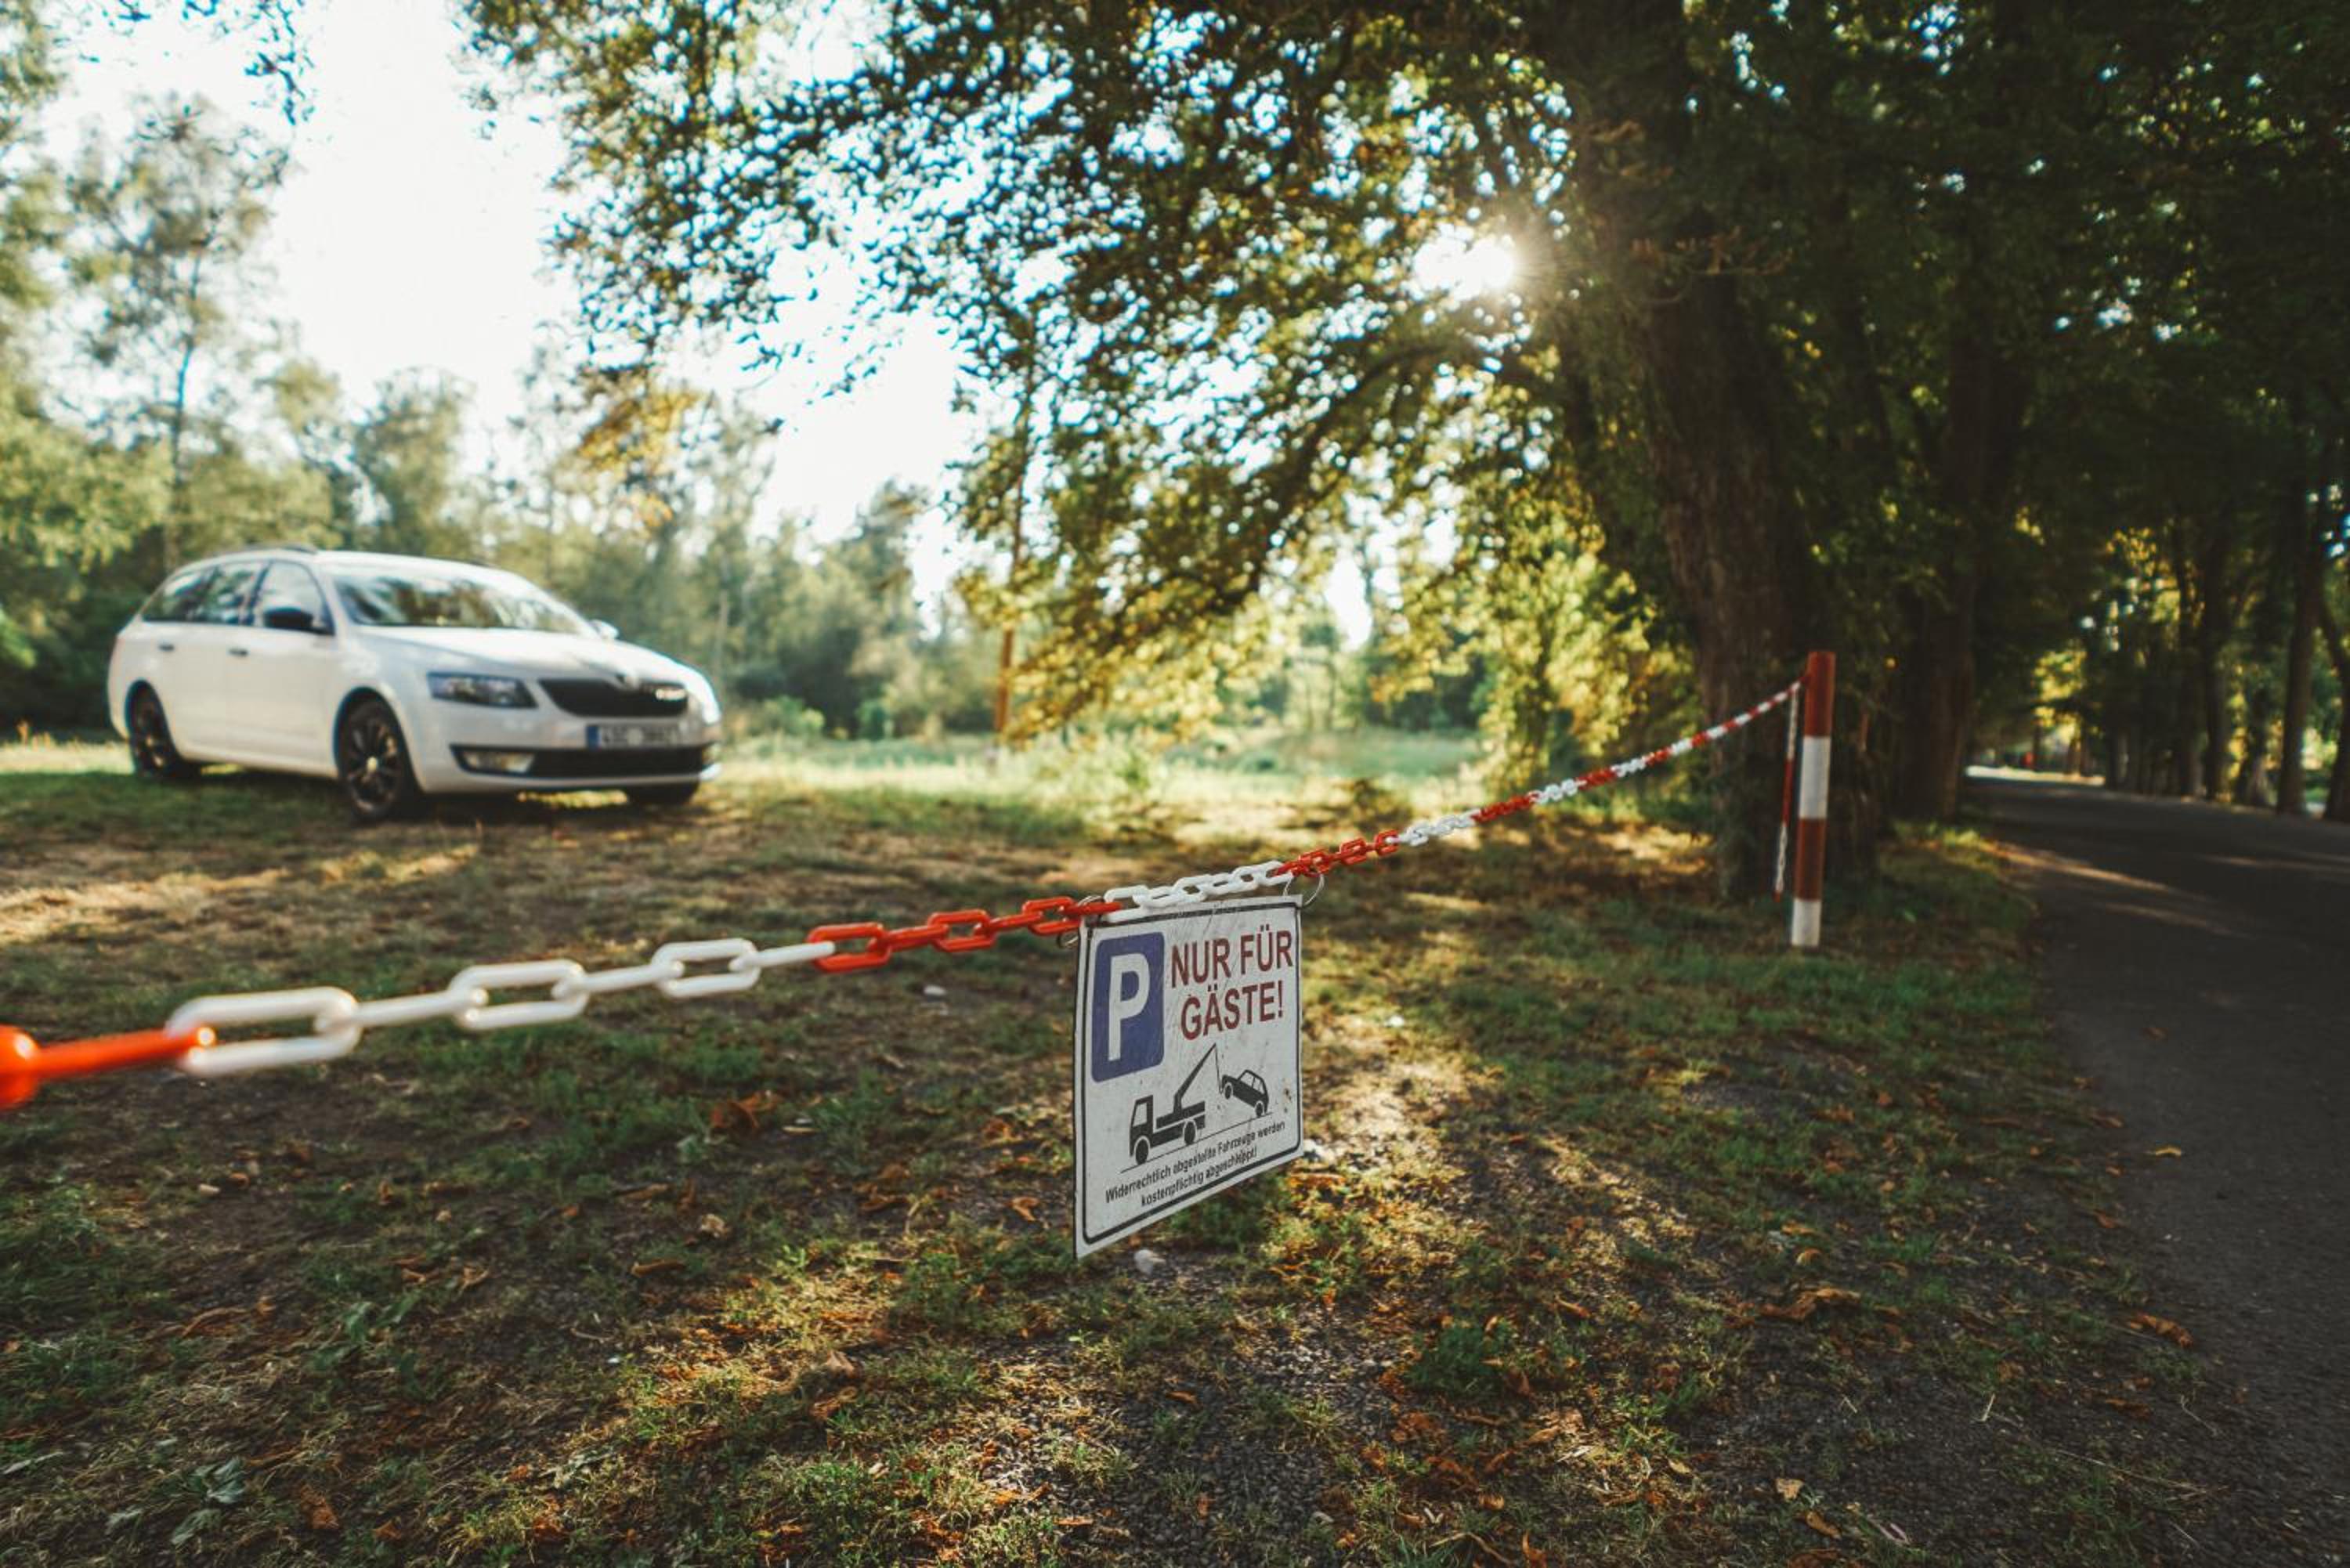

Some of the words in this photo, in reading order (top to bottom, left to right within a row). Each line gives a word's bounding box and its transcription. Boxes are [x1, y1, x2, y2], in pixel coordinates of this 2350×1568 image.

[1171, 939, 1231, 988] NUR
[1240, 924, 1293, 975] FÜR
[1108, 952, 1150, 1061] P
[1180, 980, 1283, 1040] GÄSTE!
[1105, 1165, 1170, 1203] Widerrechtlich
[1173, 1147, 1216, 1174] abgestellte
[1217, 1133, 1256, 1155] Fahrzeuge
[1257, 1122, 1285, 1138] werden
[1141, 1172, 1204, 1206] kostenpflichtig
[1206, 1145, 1256, 1178] abgeschleppt!
